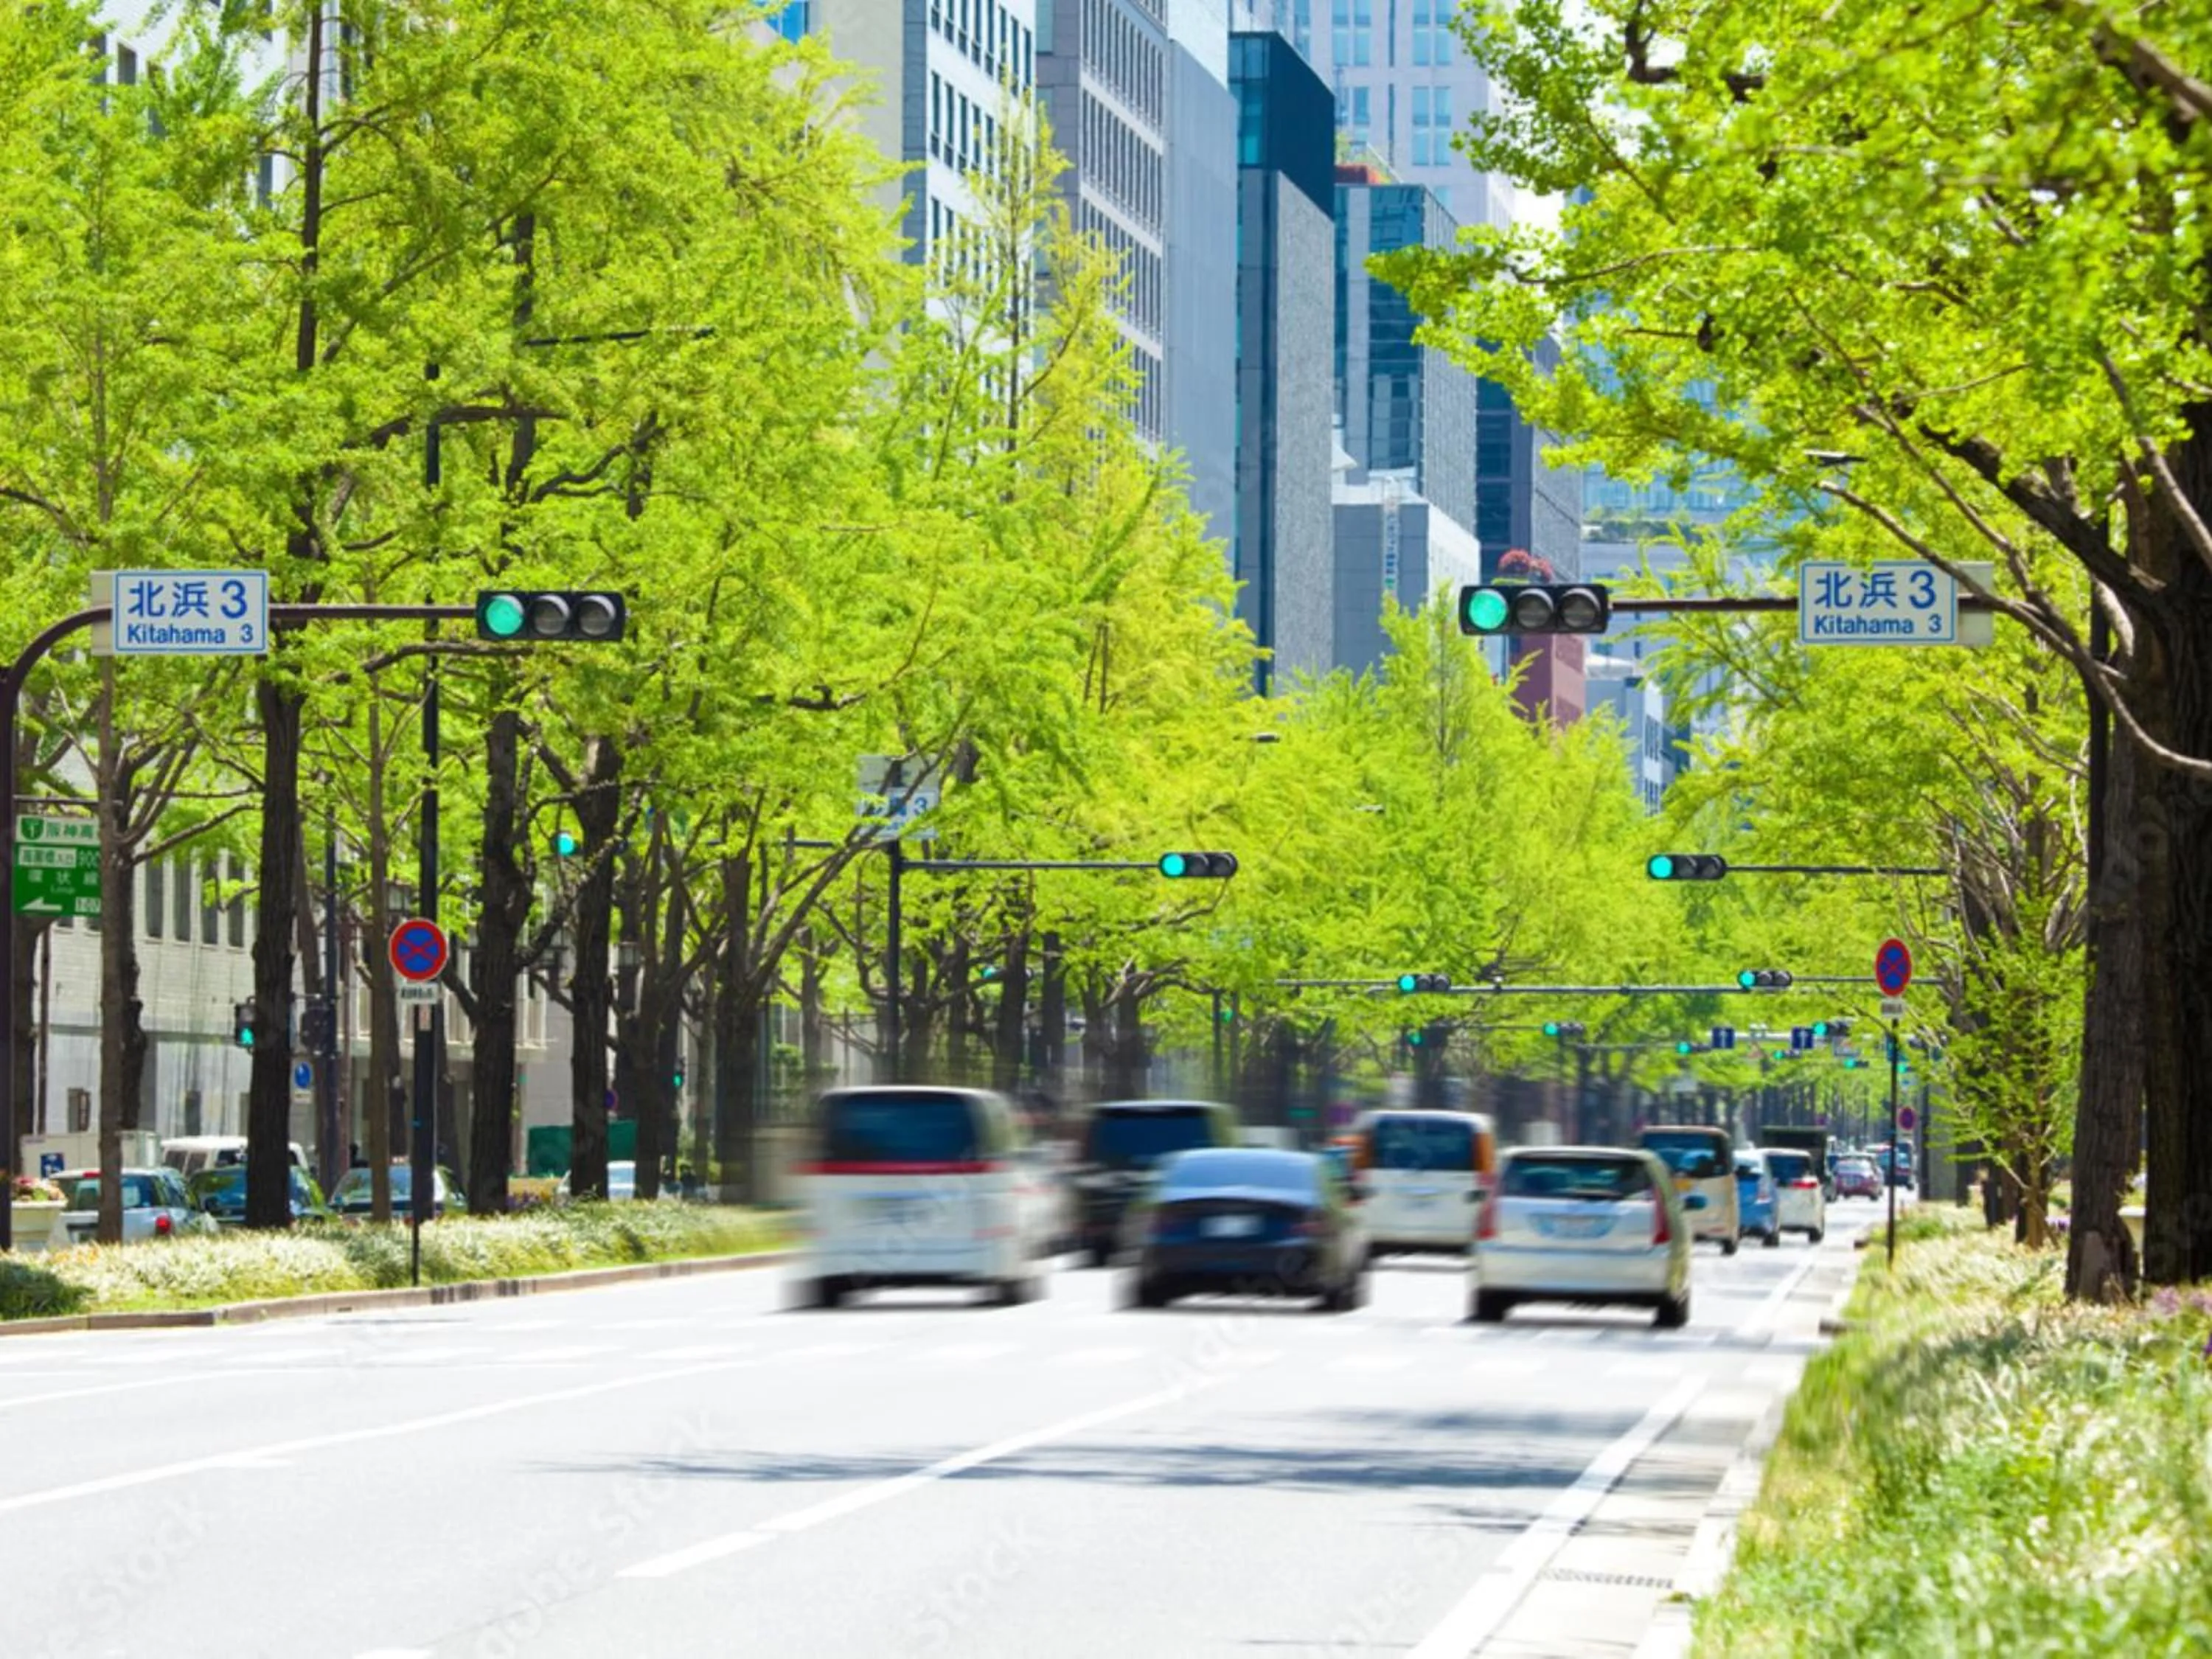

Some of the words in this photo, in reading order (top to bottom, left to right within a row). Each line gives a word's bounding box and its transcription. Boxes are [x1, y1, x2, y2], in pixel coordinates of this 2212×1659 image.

[1814, 614, 1914, 634] Kitahama
[1928, 613, 1942, 633] 3
[128, 624, 226, 644] Kitahama
[240, 624, 254, 643] 3
